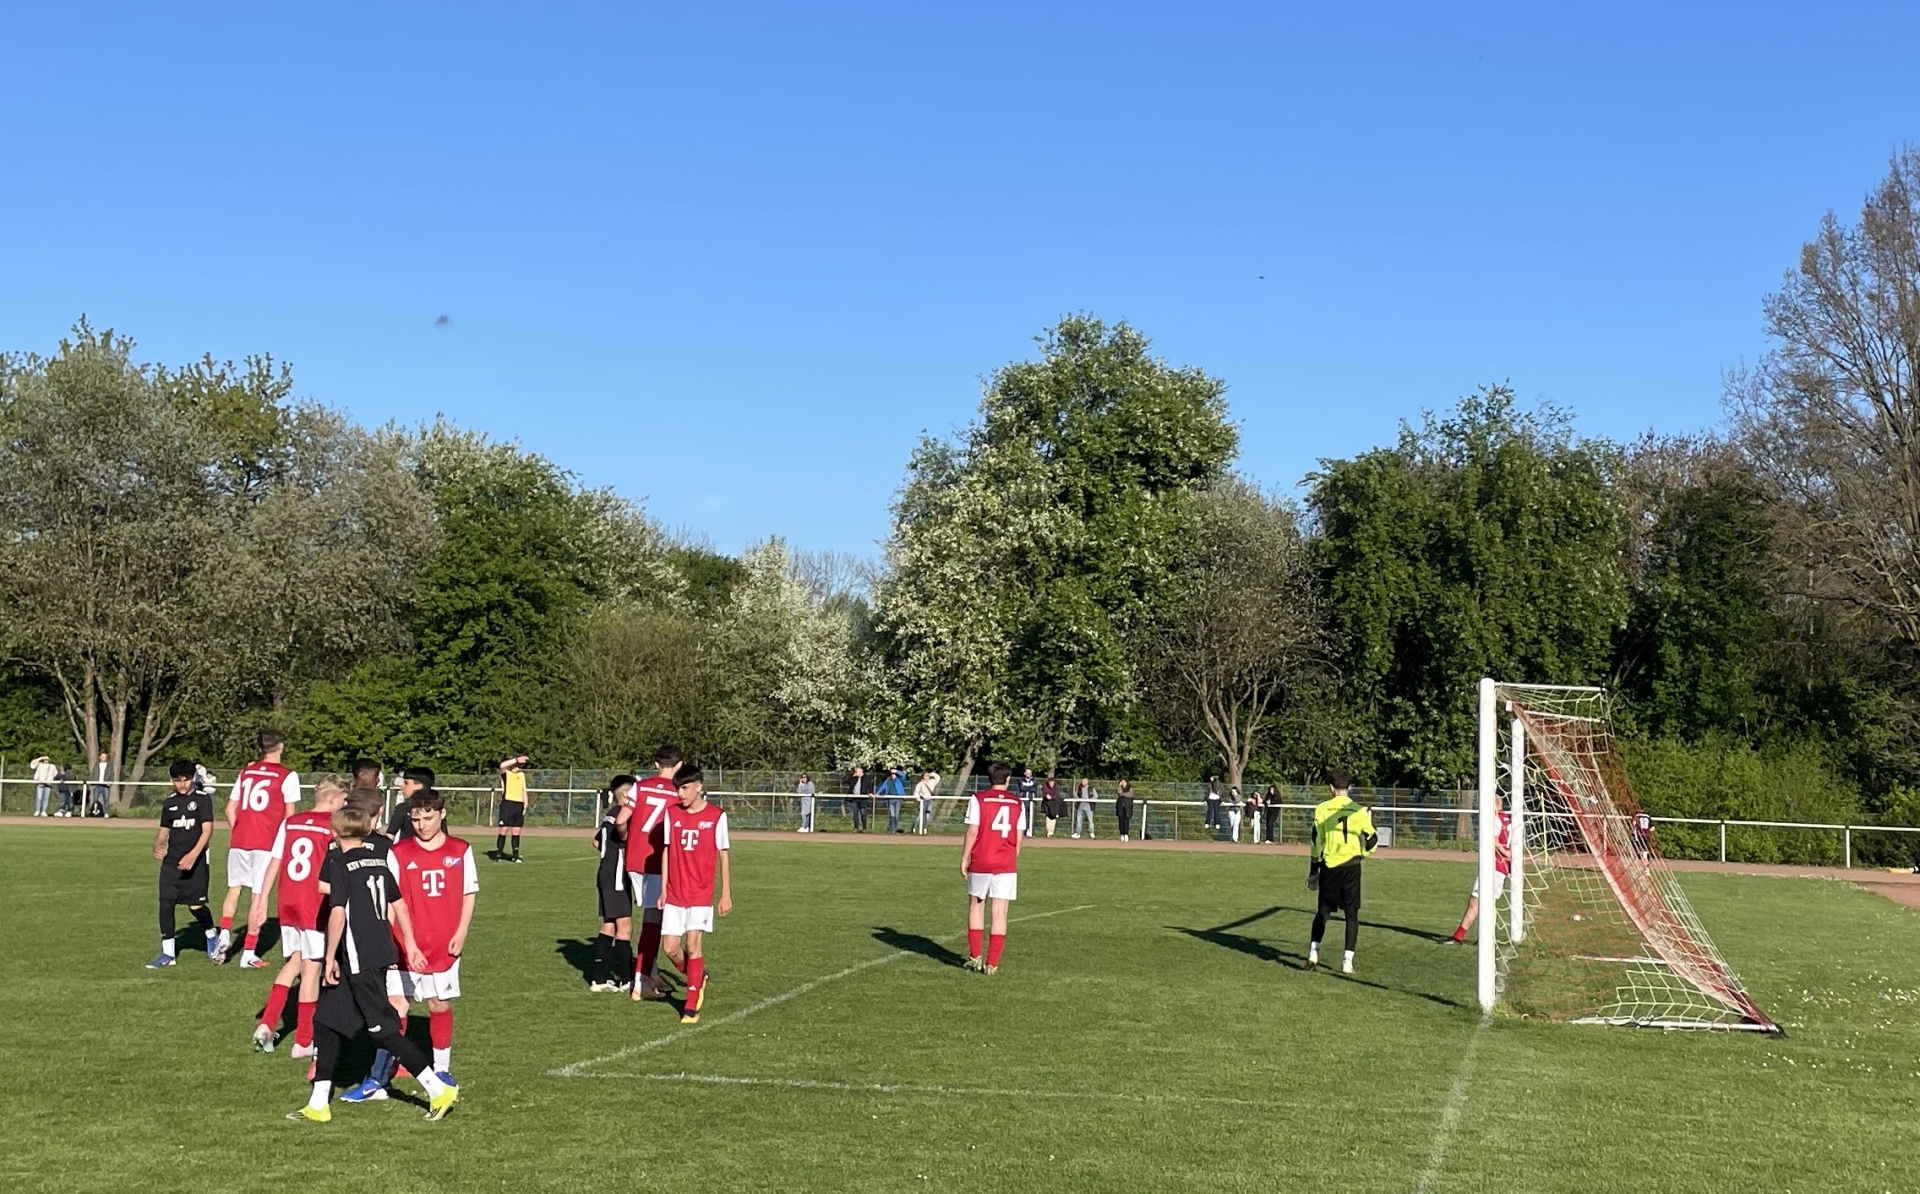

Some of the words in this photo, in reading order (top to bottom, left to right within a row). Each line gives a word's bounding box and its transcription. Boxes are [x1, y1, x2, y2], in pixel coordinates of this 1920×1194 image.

[242, 778, 271, 812] 16
[641, 796, 667, 832] 7
[991, 806, 1012, 838] 4
[1338, 816, 1348, 844] 1
[287, 837, 314, 881] 8
[366, 875, 387, 920] 11
